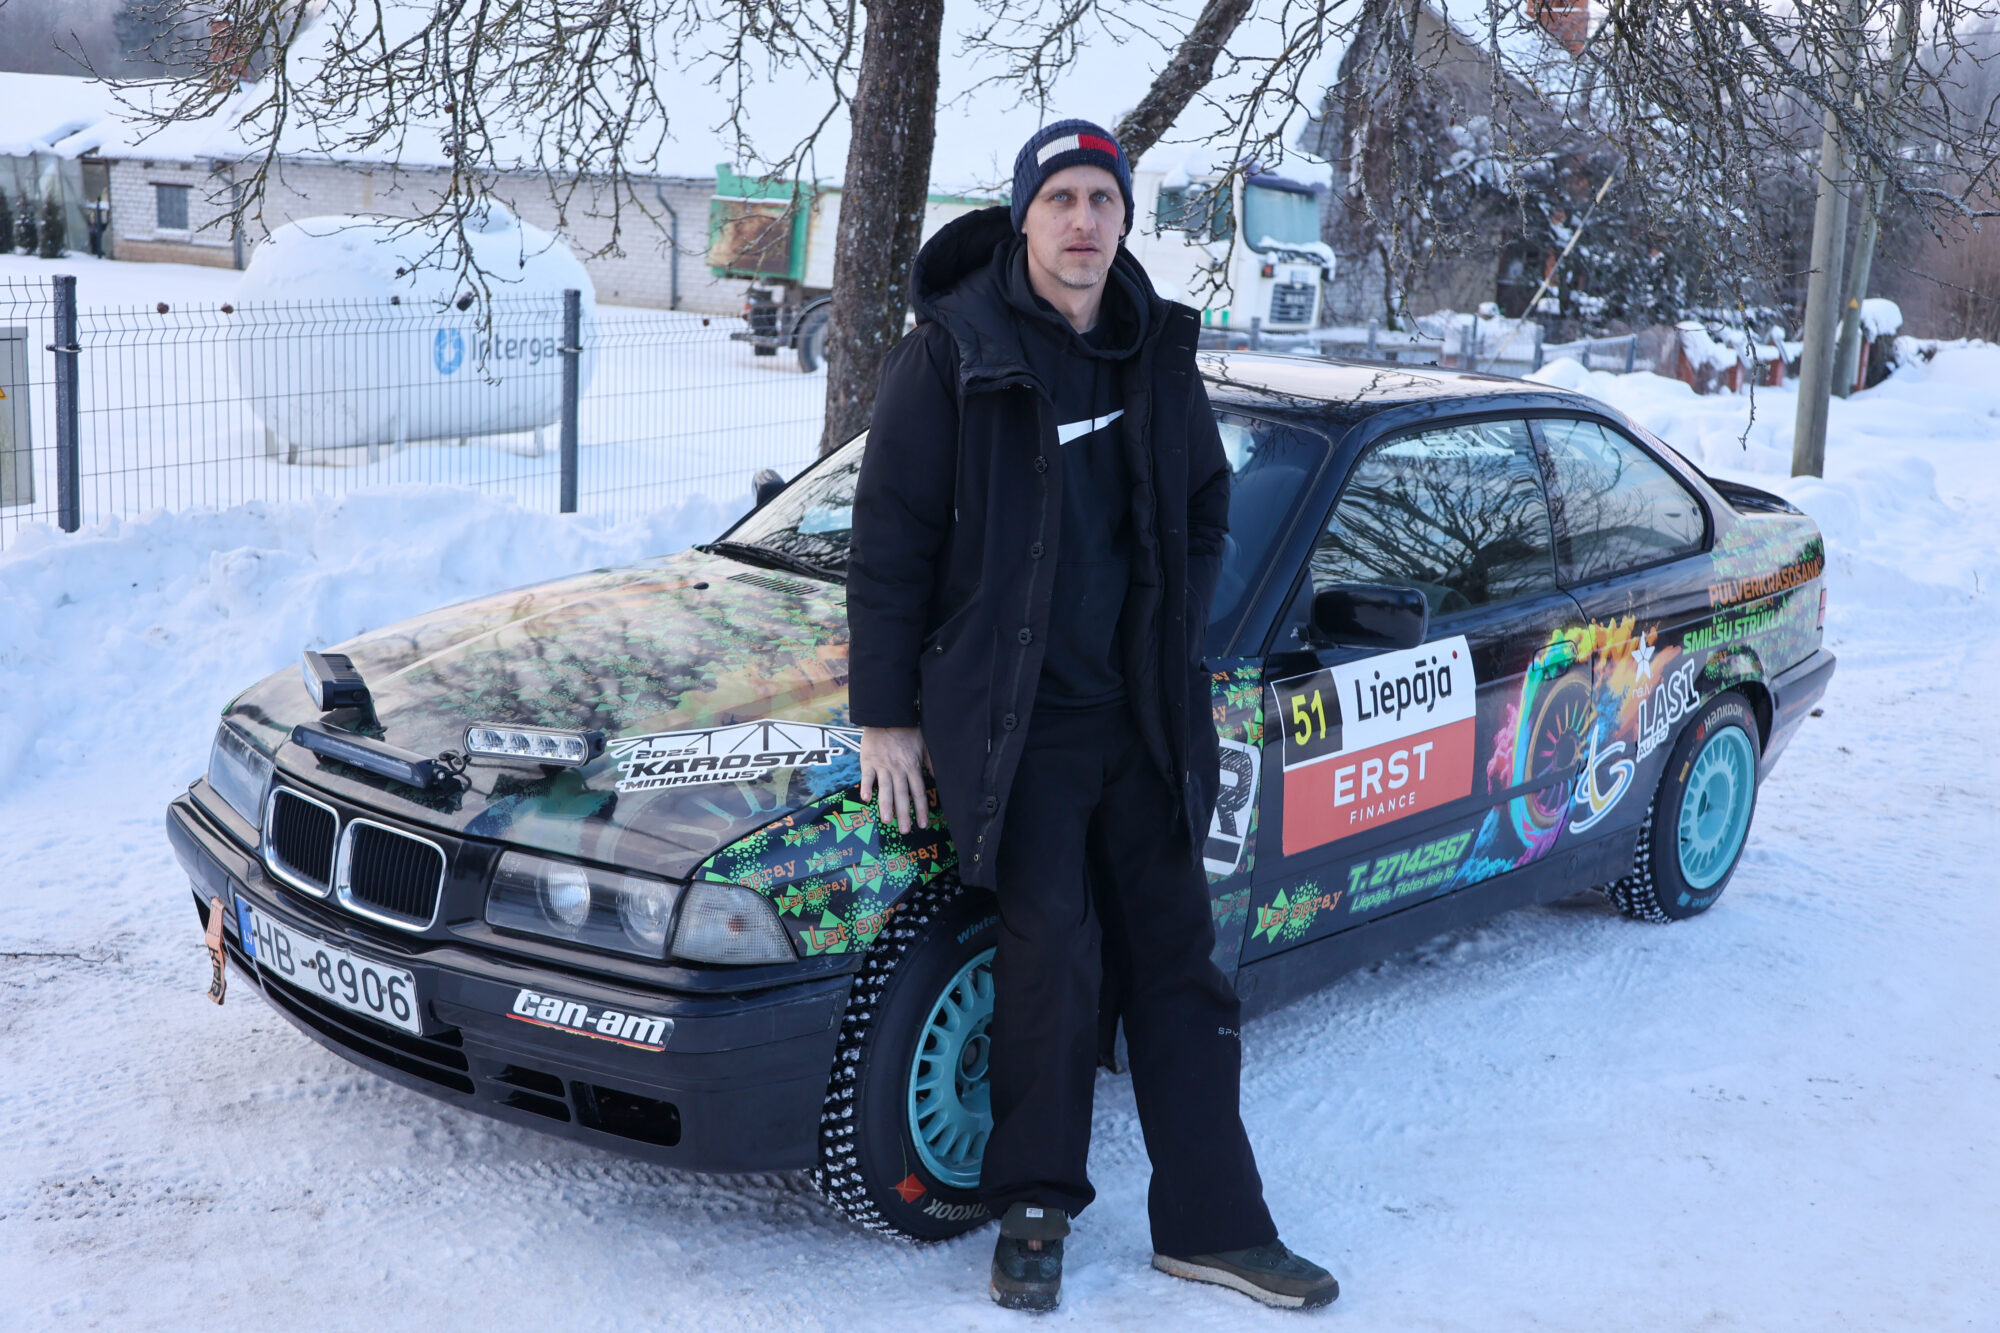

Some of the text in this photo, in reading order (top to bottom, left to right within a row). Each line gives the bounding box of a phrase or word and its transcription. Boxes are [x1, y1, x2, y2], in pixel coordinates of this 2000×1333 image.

[1355, 655, 1452, 722] Liepāja
[1638, 658, 1700, 743] LASI
[1291, 689, 1327, 746] 51
[635, 746, 699, 760] 2025
[1334, 741, 1433, 807] ERST
[833, 808, 874, 831] Lat
[1350, 792, 1416, 824] FINANCE
[852, 843, 938, 883] Lat spray
[1350, 832, 1472, 893] T. 27142567
[779, 877, 847, 909] Lat spray
[1393, 878, 1425, 897] Flotes
[1261, 889, 1343, 928] Lat spray
[809, 922, 850, 949] Lat
[243, 914, 411, 1021] LV HB-8906
[512, 988, 666, 1045] can-am
[1218, 1026, 1241, 1040] SPY
